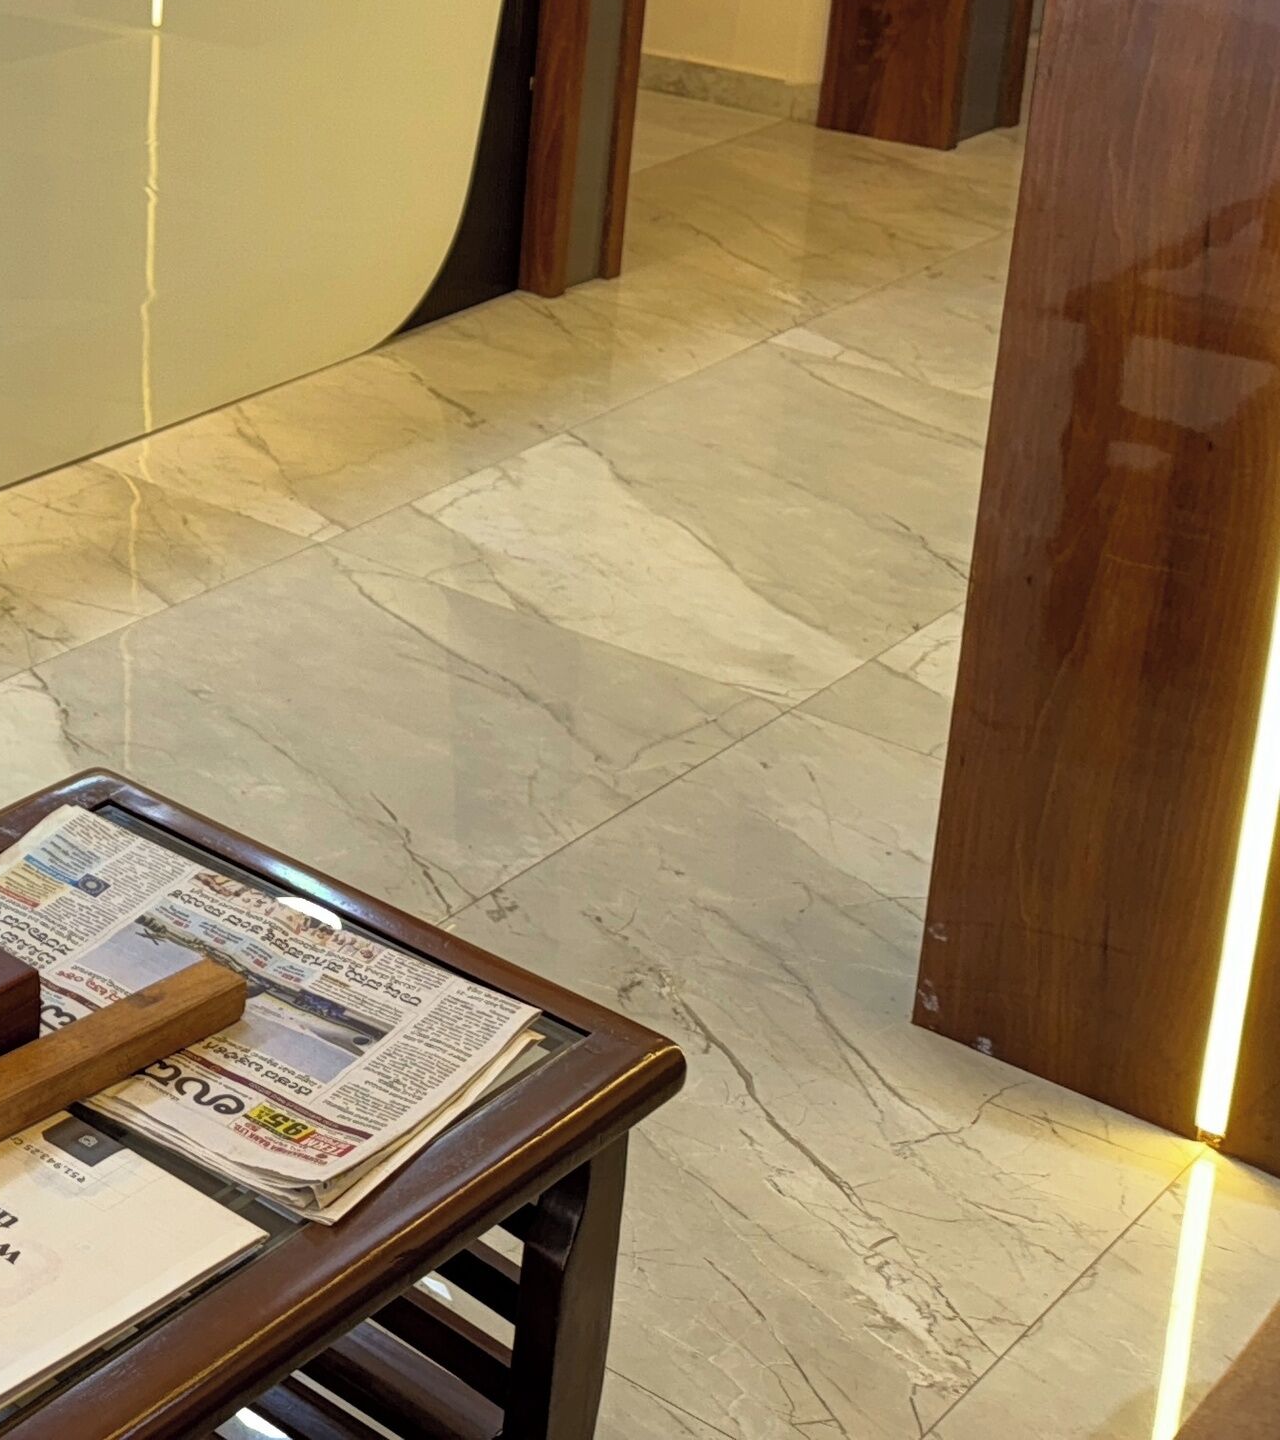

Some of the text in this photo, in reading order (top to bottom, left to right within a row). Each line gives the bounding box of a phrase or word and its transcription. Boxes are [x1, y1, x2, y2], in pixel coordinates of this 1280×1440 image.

[168, 890, 225, 916] ನಾಯಕ
[223, 915, 263, 933] ತಂದ
[1, 932, 56, 964] ಬಿಸಿಸಿಐ
[345, 966, 421, 1006] ರಾಜ್ಯವನ್ನು
[261, 1071, 312, 1095] ದೇಶದ
[245, 1133, 272, 1147] BANK
